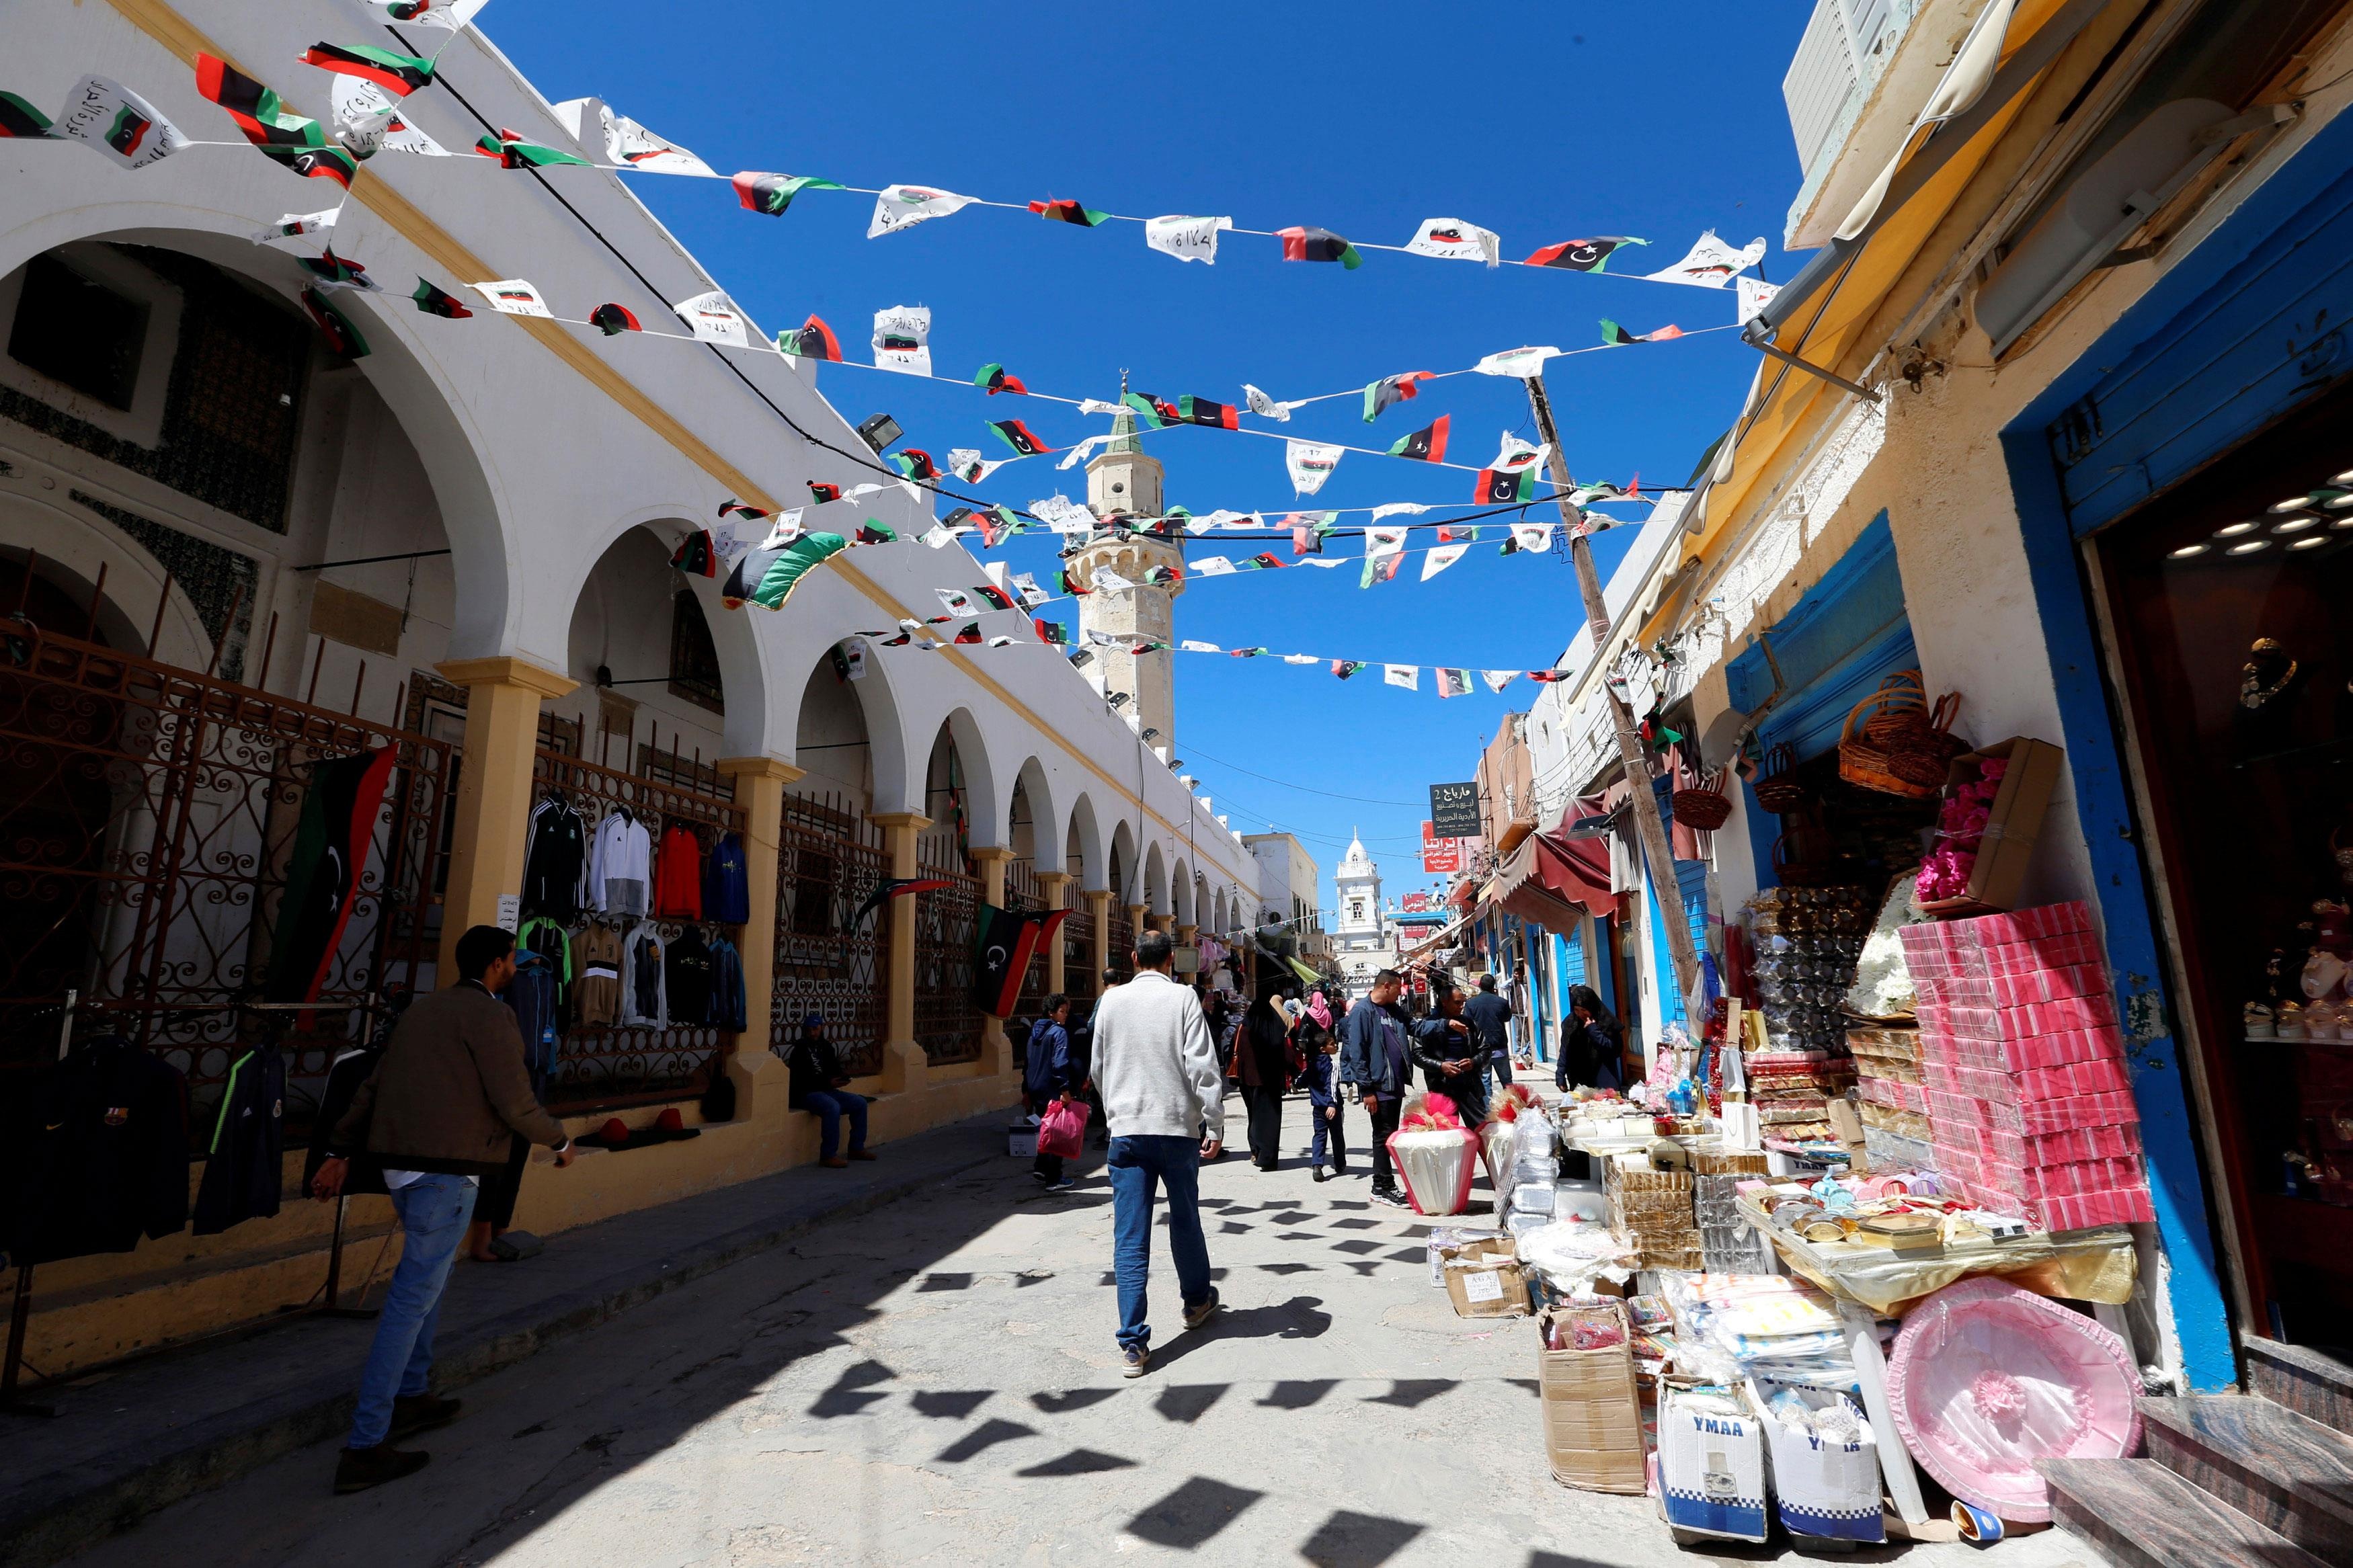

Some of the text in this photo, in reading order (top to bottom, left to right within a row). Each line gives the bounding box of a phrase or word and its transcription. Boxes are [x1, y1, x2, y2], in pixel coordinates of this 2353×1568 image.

[1434, 786, 1471, 802] مارياج 2
[1436, 813, 1458, 823] الحريرية
[1437, 951, 1443, 960] 2
[1693, 1416, 1744, 1437] YMAA
[1808, 1436, 1862, 1453] YA
